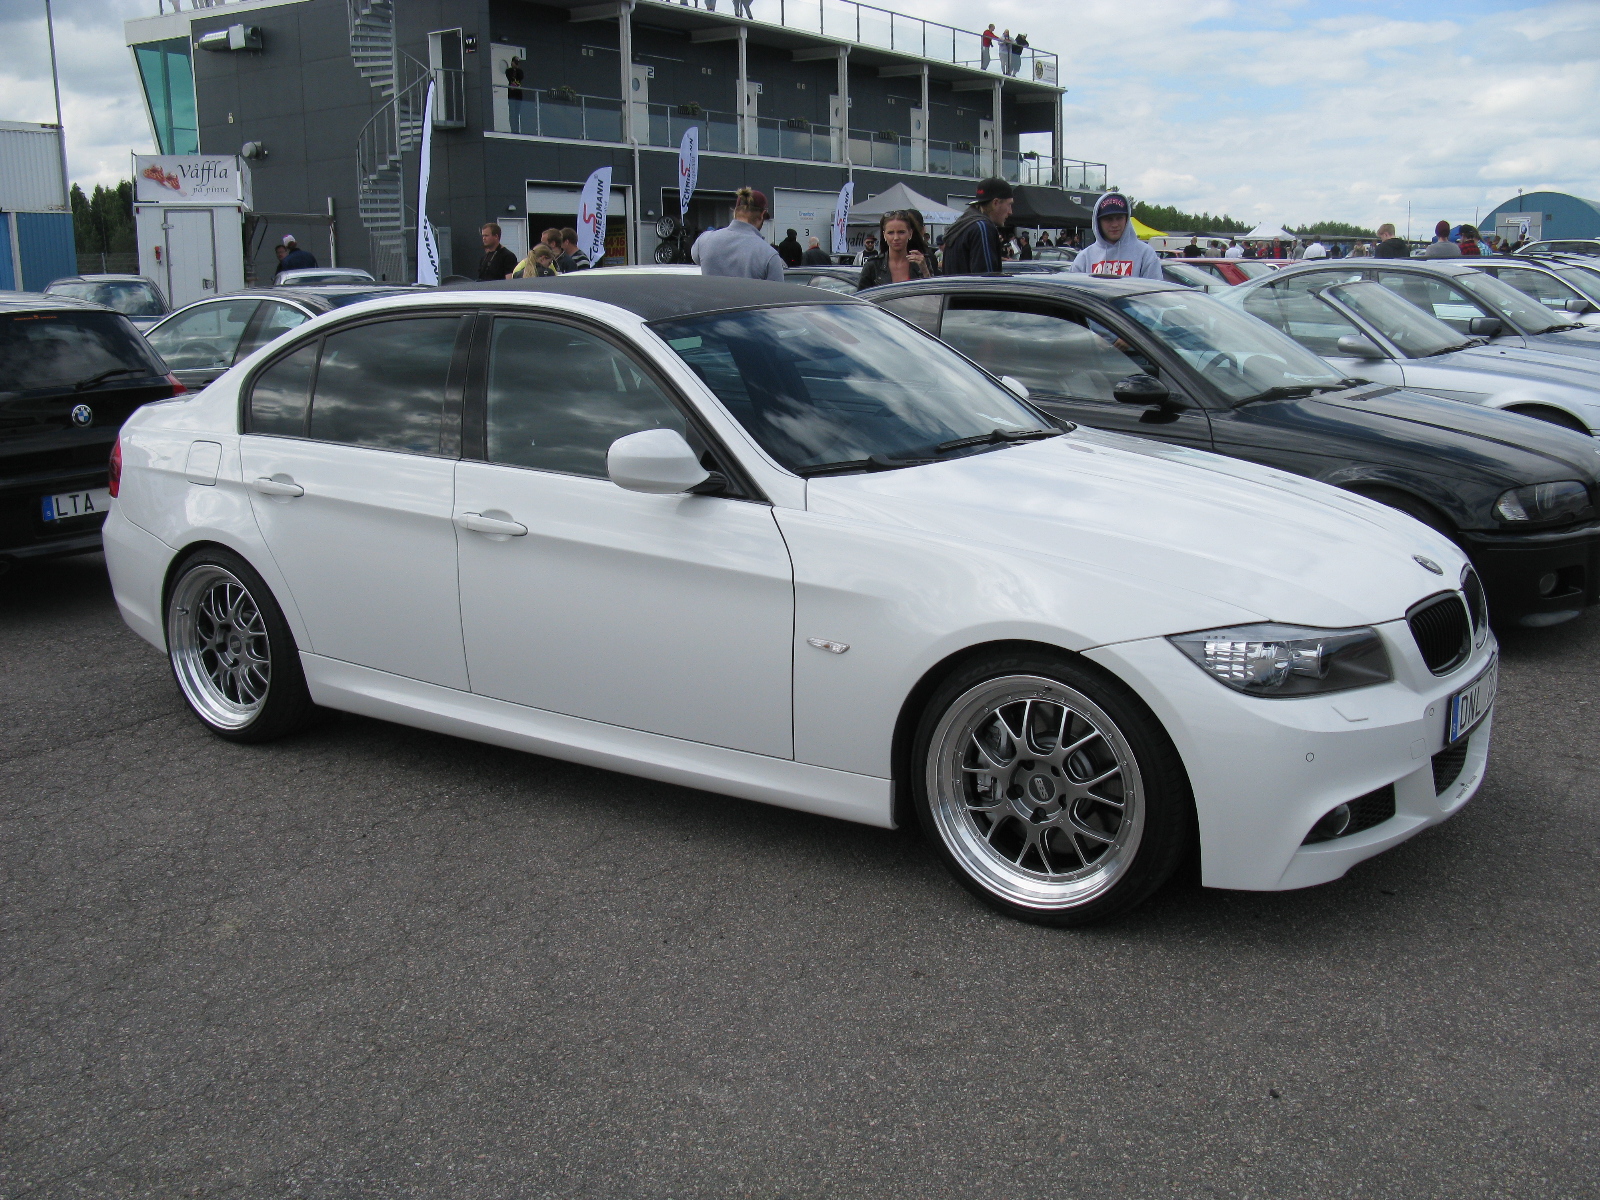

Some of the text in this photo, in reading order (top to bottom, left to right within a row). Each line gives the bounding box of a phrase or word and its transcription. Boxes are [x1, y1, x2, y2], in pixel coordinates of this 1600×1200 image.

[177, 160, 228, 187] Våffla
[191, 186, 203, 197] på
[804, 228, 810, 237] 3
[55, 492, 95, 517] LTA
[1459, 685, 1481, 730] DNL
